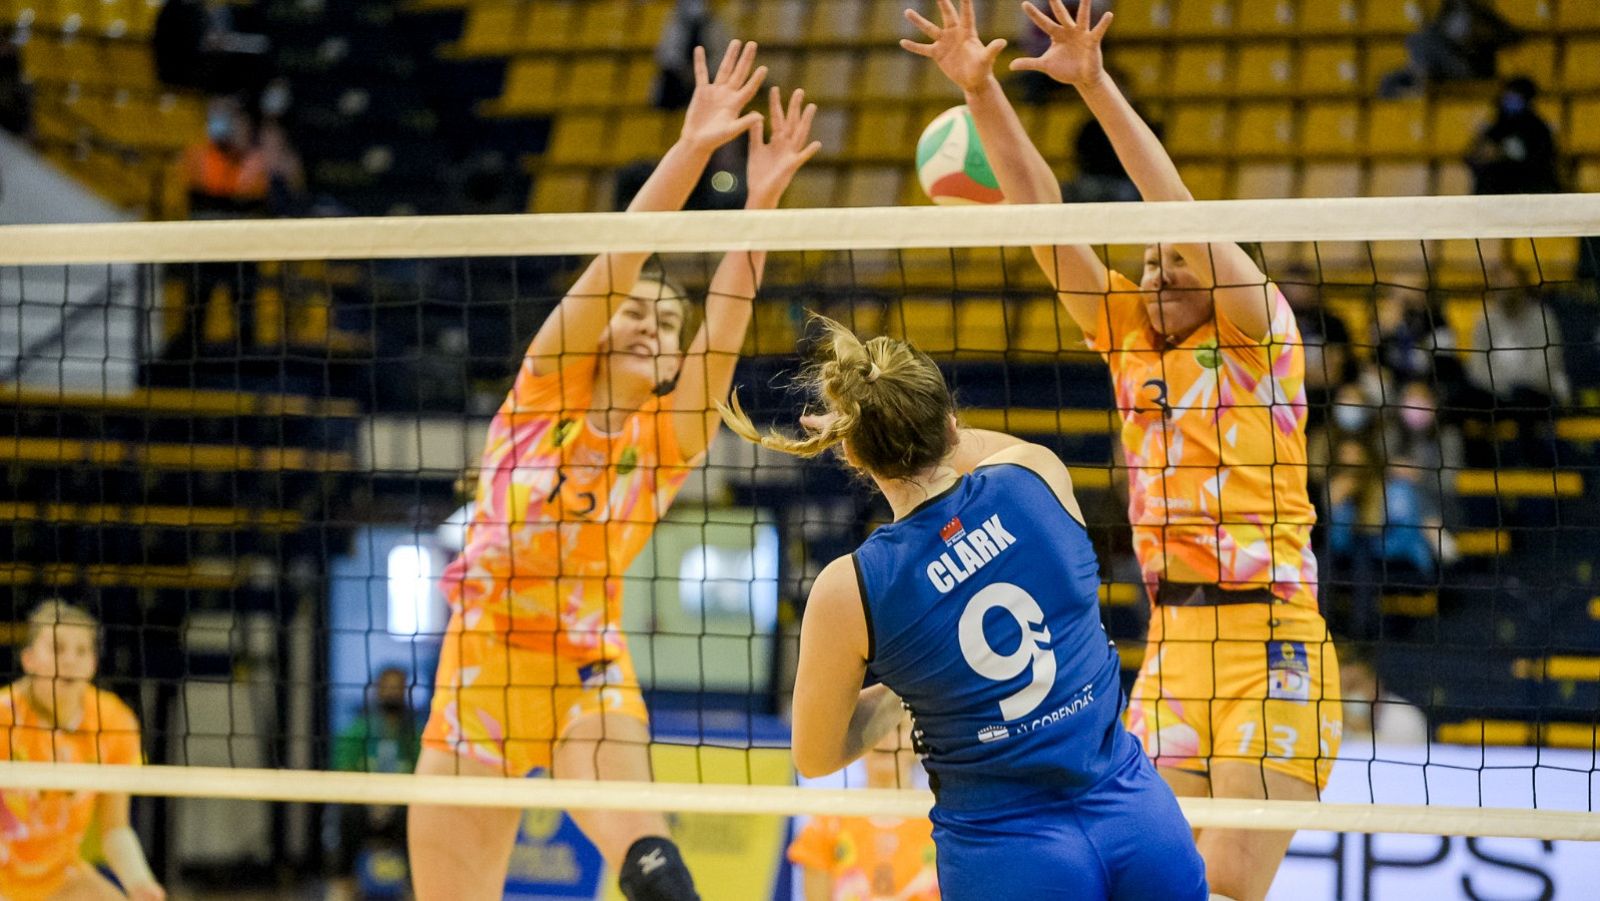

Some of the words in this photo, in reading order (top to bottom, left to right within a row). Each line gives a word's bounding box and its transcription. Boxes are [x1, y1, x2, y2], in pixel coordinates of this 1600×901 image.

[926, 513, 1017, 594] CLARK
[957, 581, 1057, 722] 9
[1236, 720, 1299, 763] 13
